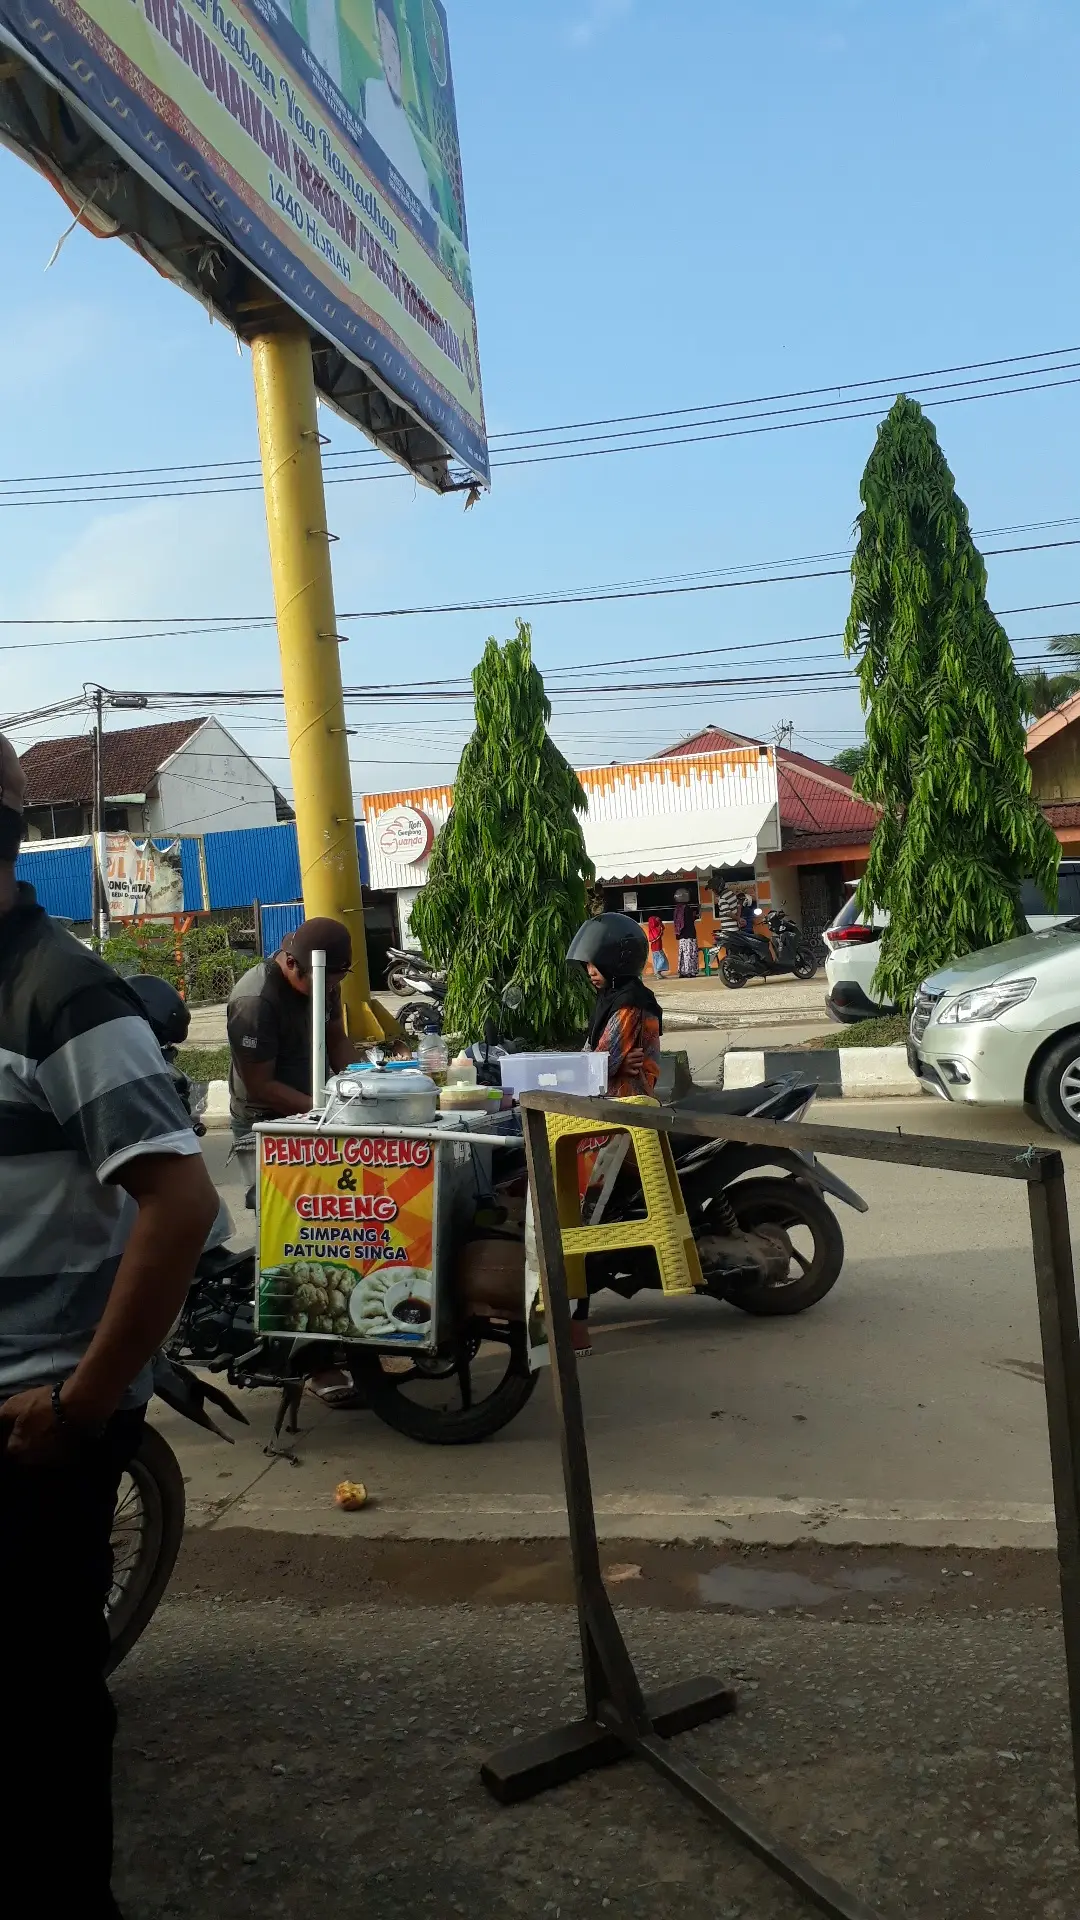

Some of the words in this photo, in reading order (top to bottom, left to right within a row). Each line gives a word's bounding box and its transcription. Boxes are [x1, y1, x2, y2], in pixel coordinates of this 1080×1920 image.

[143, 0, 292, 181] MENUNAIKAN
[279, 78, 317, 154] Yaa
[319, 128, 400, 254] Ramadhan
[268, 173, 304, 230] 1440
[408, 820, 422, 829] Roti
[263, 1137, 341, 1165] PENTOL
[342, 1137, 432, 1168] GORENG
[337, 1168, 357, 1191] &
[295, 1194, 397, 1221] CIRENG
[299, 1226, 376, 1243] SIMPANG
[380, 1229, 391, 1243] 4
[283, 1243, 351, 1258] PATUNG
[354, 1245, 408, 1261] SINGA
